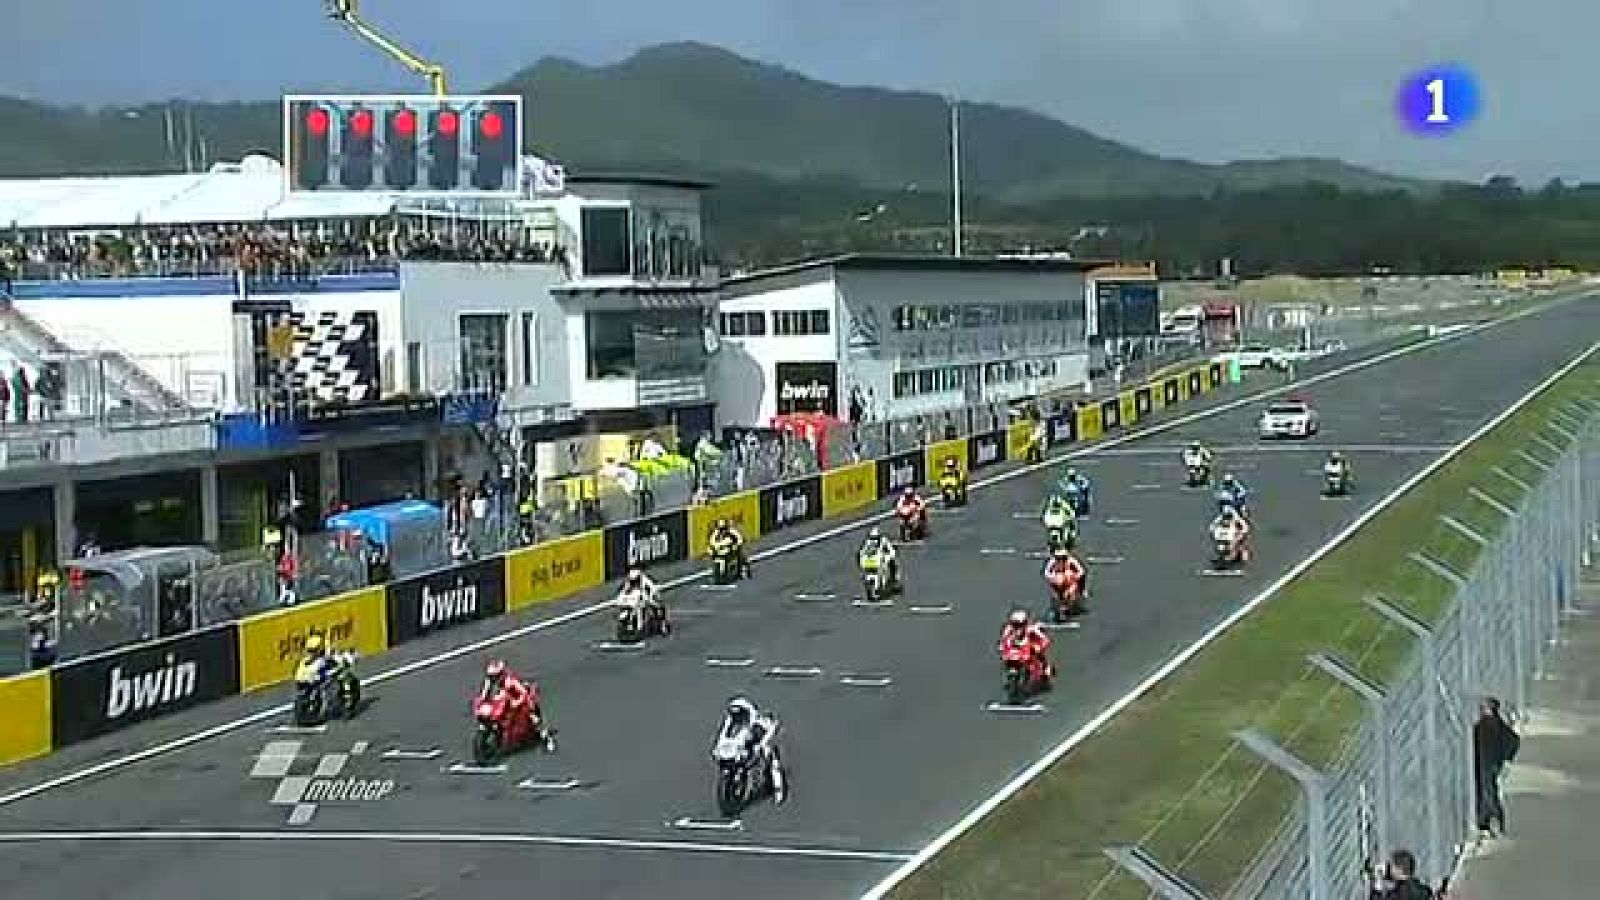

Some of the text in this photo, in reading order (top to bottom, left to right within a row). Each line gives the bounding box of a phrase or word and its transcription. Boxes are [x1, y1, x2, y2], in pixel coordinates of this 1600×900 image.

[781, 380, 828, 399] bwin
[421, 577, 476, 627] bwin
[107, 653, 197, 718] bwin
